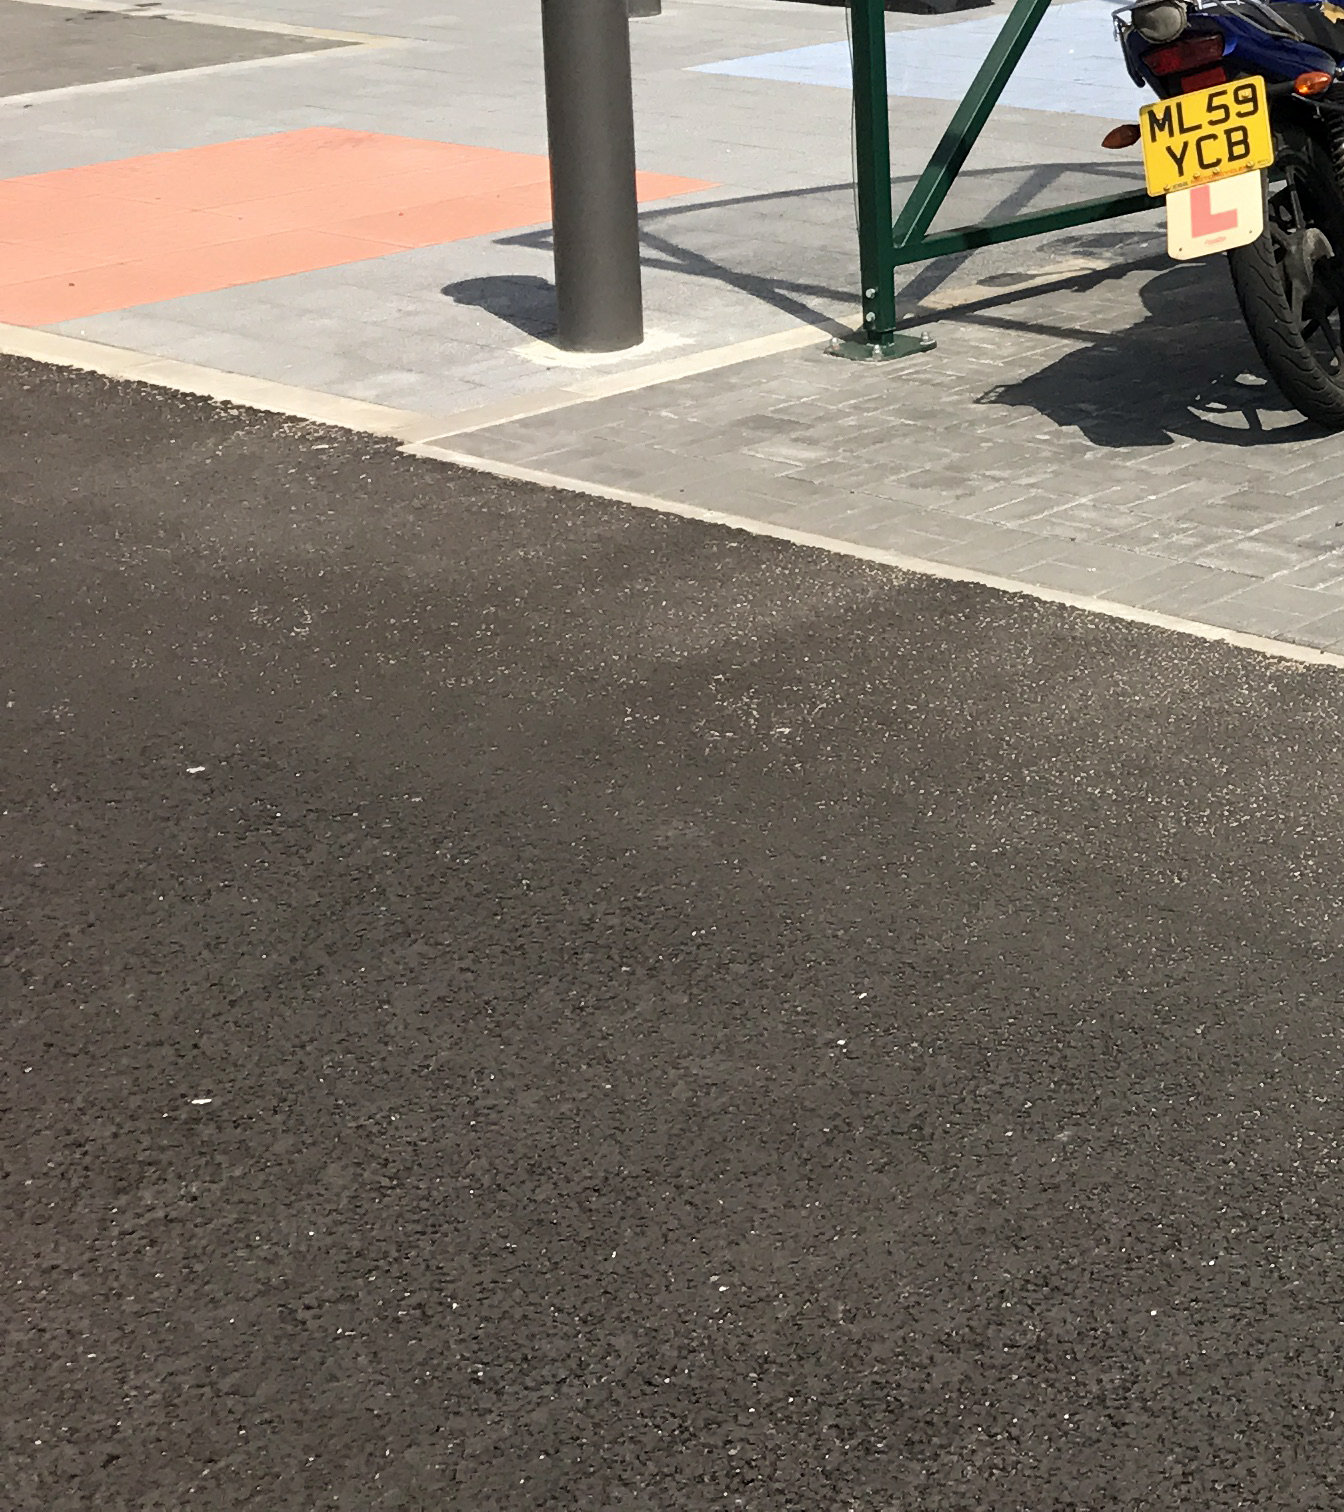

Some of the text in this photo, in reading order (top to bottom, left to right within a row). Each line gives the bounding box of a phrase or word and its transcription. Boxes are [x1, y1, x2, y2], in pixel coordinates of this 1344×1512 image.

[1147, 83, 1259, 144] ML59
[1165, 125, 1251, 177] YCB
[1190, 184, 1238, 239] L
